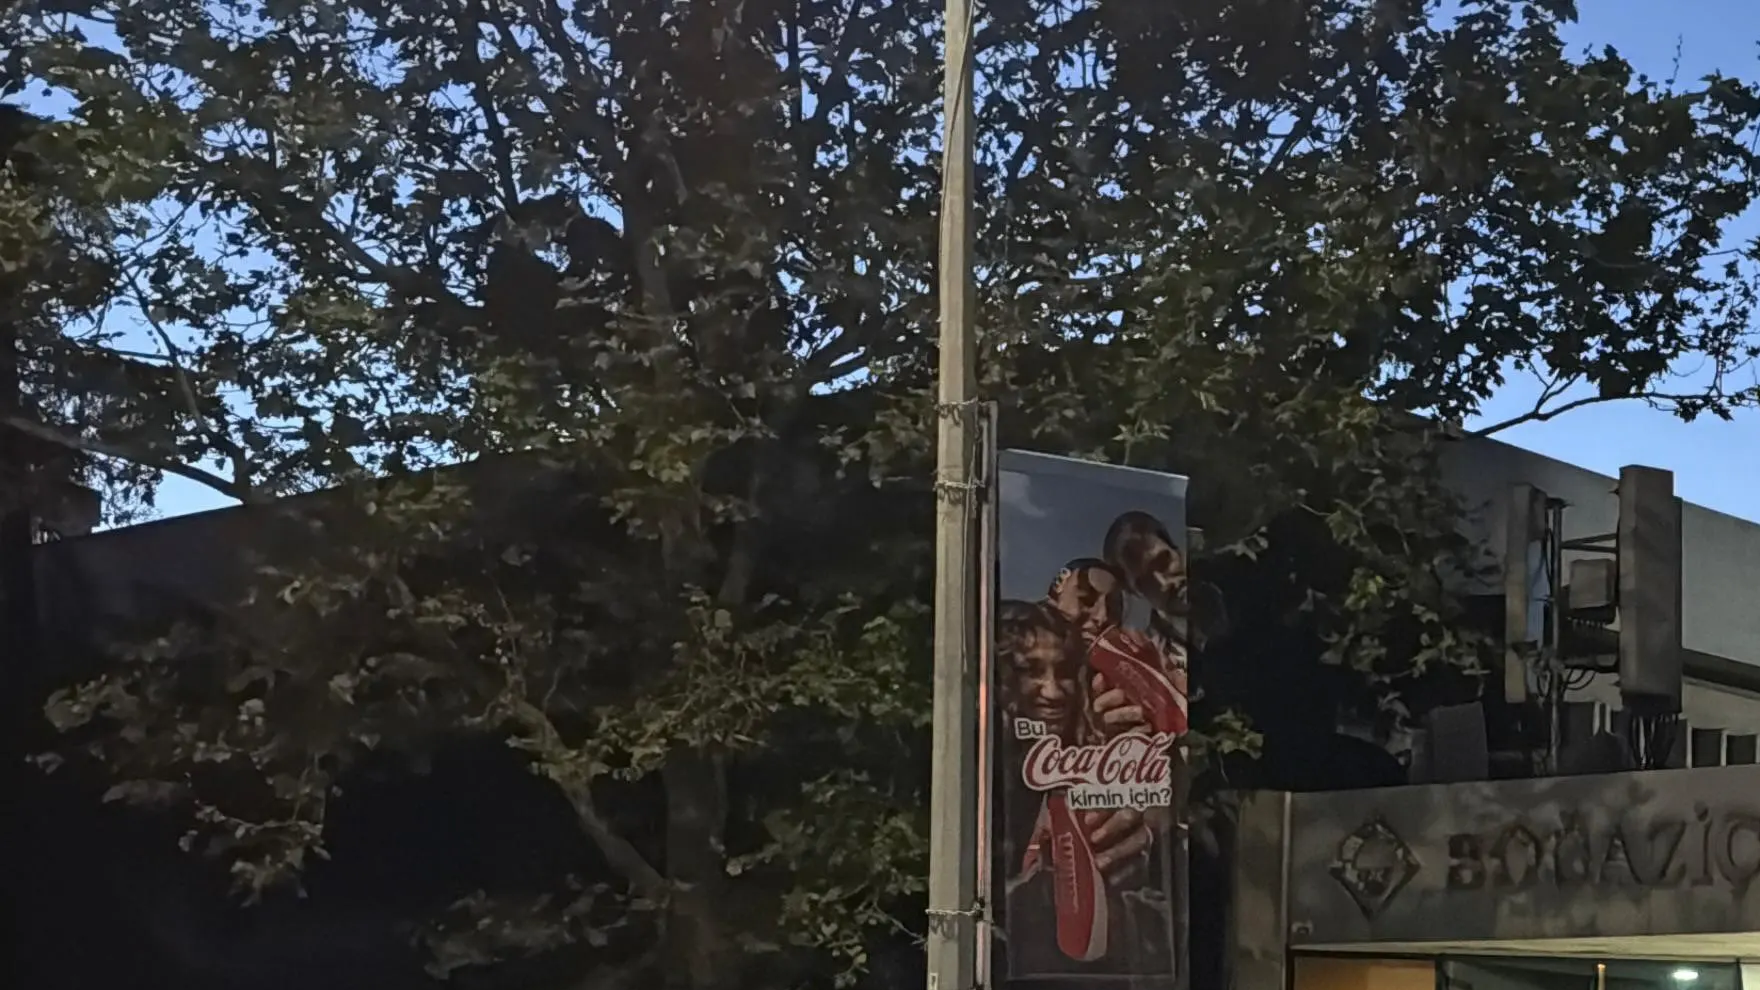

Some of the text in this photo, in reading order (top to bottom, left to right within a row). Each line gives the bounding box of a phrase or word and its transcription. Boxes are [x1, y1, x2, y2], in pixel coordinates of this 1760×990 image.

[1016, 720, 1045, 737] Bu
[1024, 735, 1172, 788] Coca-Cola
[1070, 787, 1171, 809] kimin için?
